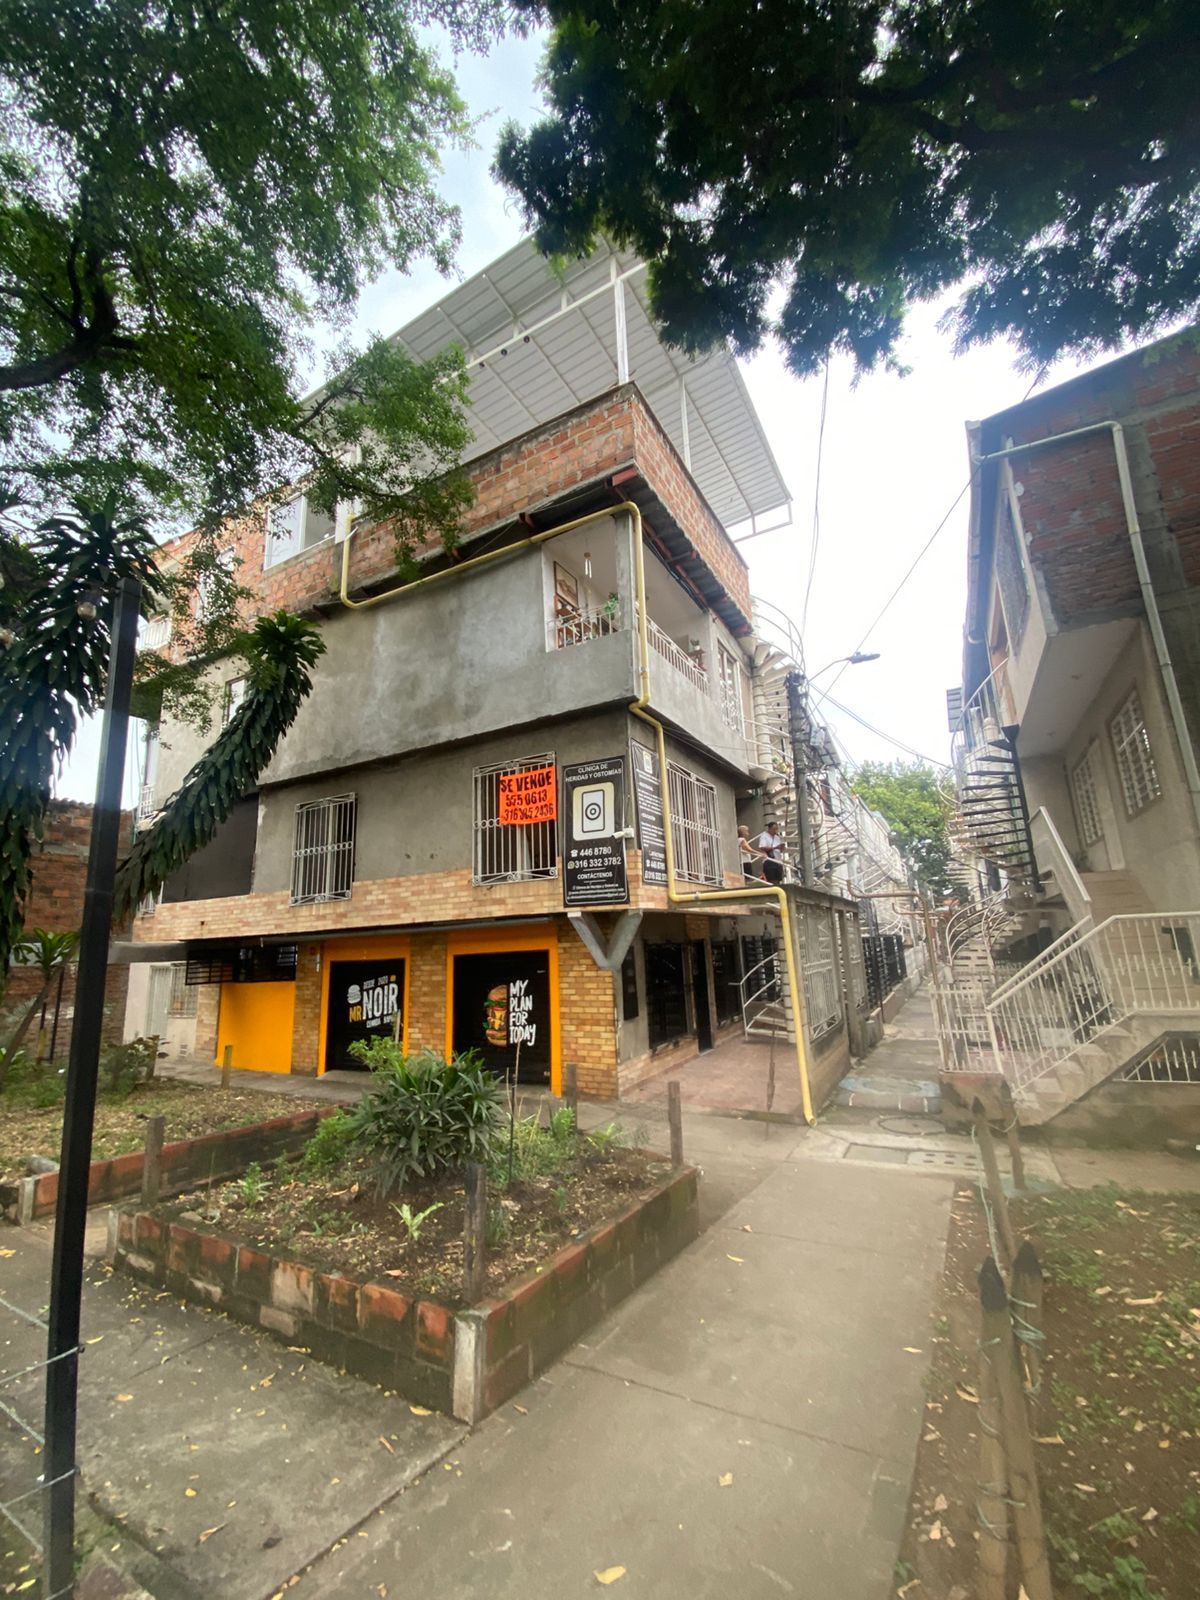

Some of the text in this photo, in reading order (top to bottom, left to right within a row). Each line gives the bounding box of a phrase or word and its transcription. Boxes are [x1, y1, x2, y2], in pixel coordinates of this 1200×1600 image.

[500, 770, 552, 793] SE VENDE
[565, 774, 588, 782] HERIDAS
[524, 788, 548, 806] 0613
[504, 808, 519, 821] 316
[579, 846, 612, 857] 446 8780
[575, 856, 622, 869] 316 332 3782
[509, 979, 529, 997] MY
[362, 983, 399, 1020] NOIR
[509, 994, 533, 1012] PLAN
[349, 1005, 362, 1023] MR
[509, 1011, 529, 1026] FOR
[509, 1023, 537, 1047] TODAY
